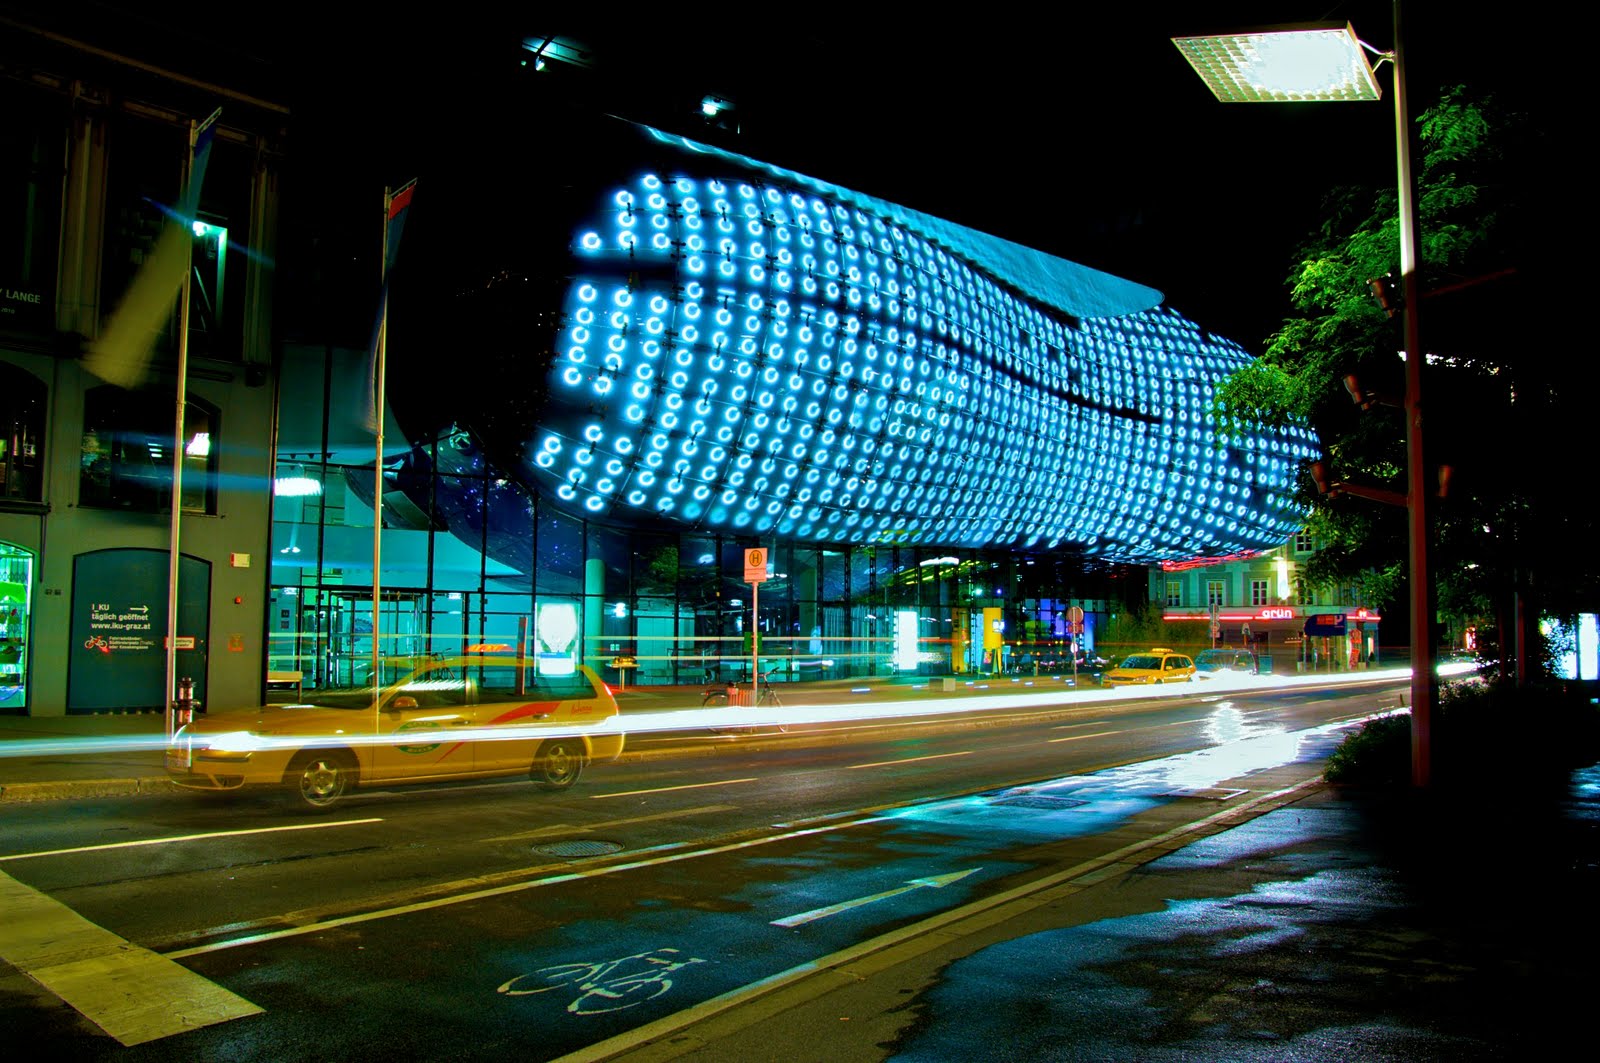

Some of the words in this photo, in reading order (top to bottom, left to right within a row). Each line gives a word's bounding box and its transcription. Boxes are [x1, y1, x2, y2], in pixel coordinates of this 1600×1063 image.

[5, 289, 41, 305] LANGE
[91, 613, 117, 621] täglich
[118, 613, 149, 621] geöffnet
[1261, 608, 1292, 619] grün
[91, 622, 151, 631] www.iku-graz.at
